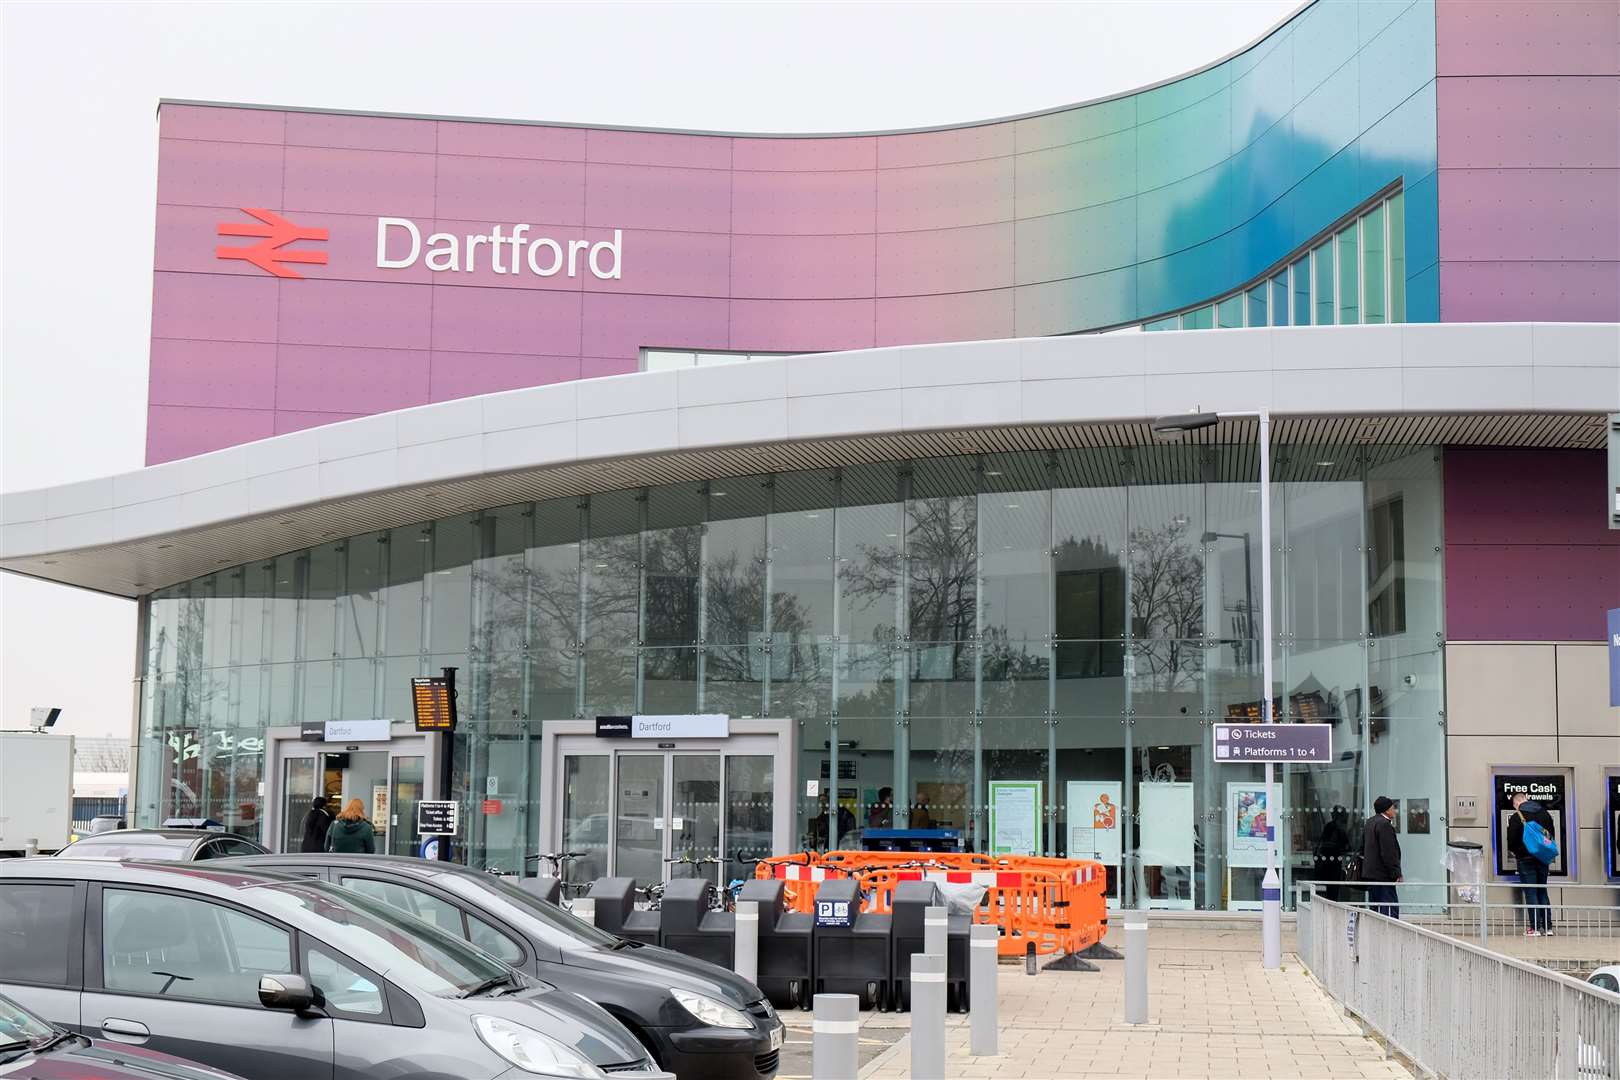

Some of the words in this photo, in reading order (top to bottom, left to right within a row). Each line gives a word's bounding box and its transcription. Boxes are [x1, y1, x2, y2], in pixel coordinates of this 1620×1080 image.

[376, 217, 622, 280] Dartford
[639, 722, 671, 731] Dartford
[329, 727, 352, 736] Dartford
[1244, 730, 1276, 739] Tickets
[1244, 747, 1287, 756] Platforms
[1290, 748, 1294, 756] 1
[1297, 748, 1307, 756] to
[1309, 748, 1316, 756] 4
[1504, 783, 1528, 793] Free
[1530, 783, 1557, 793] Cash
